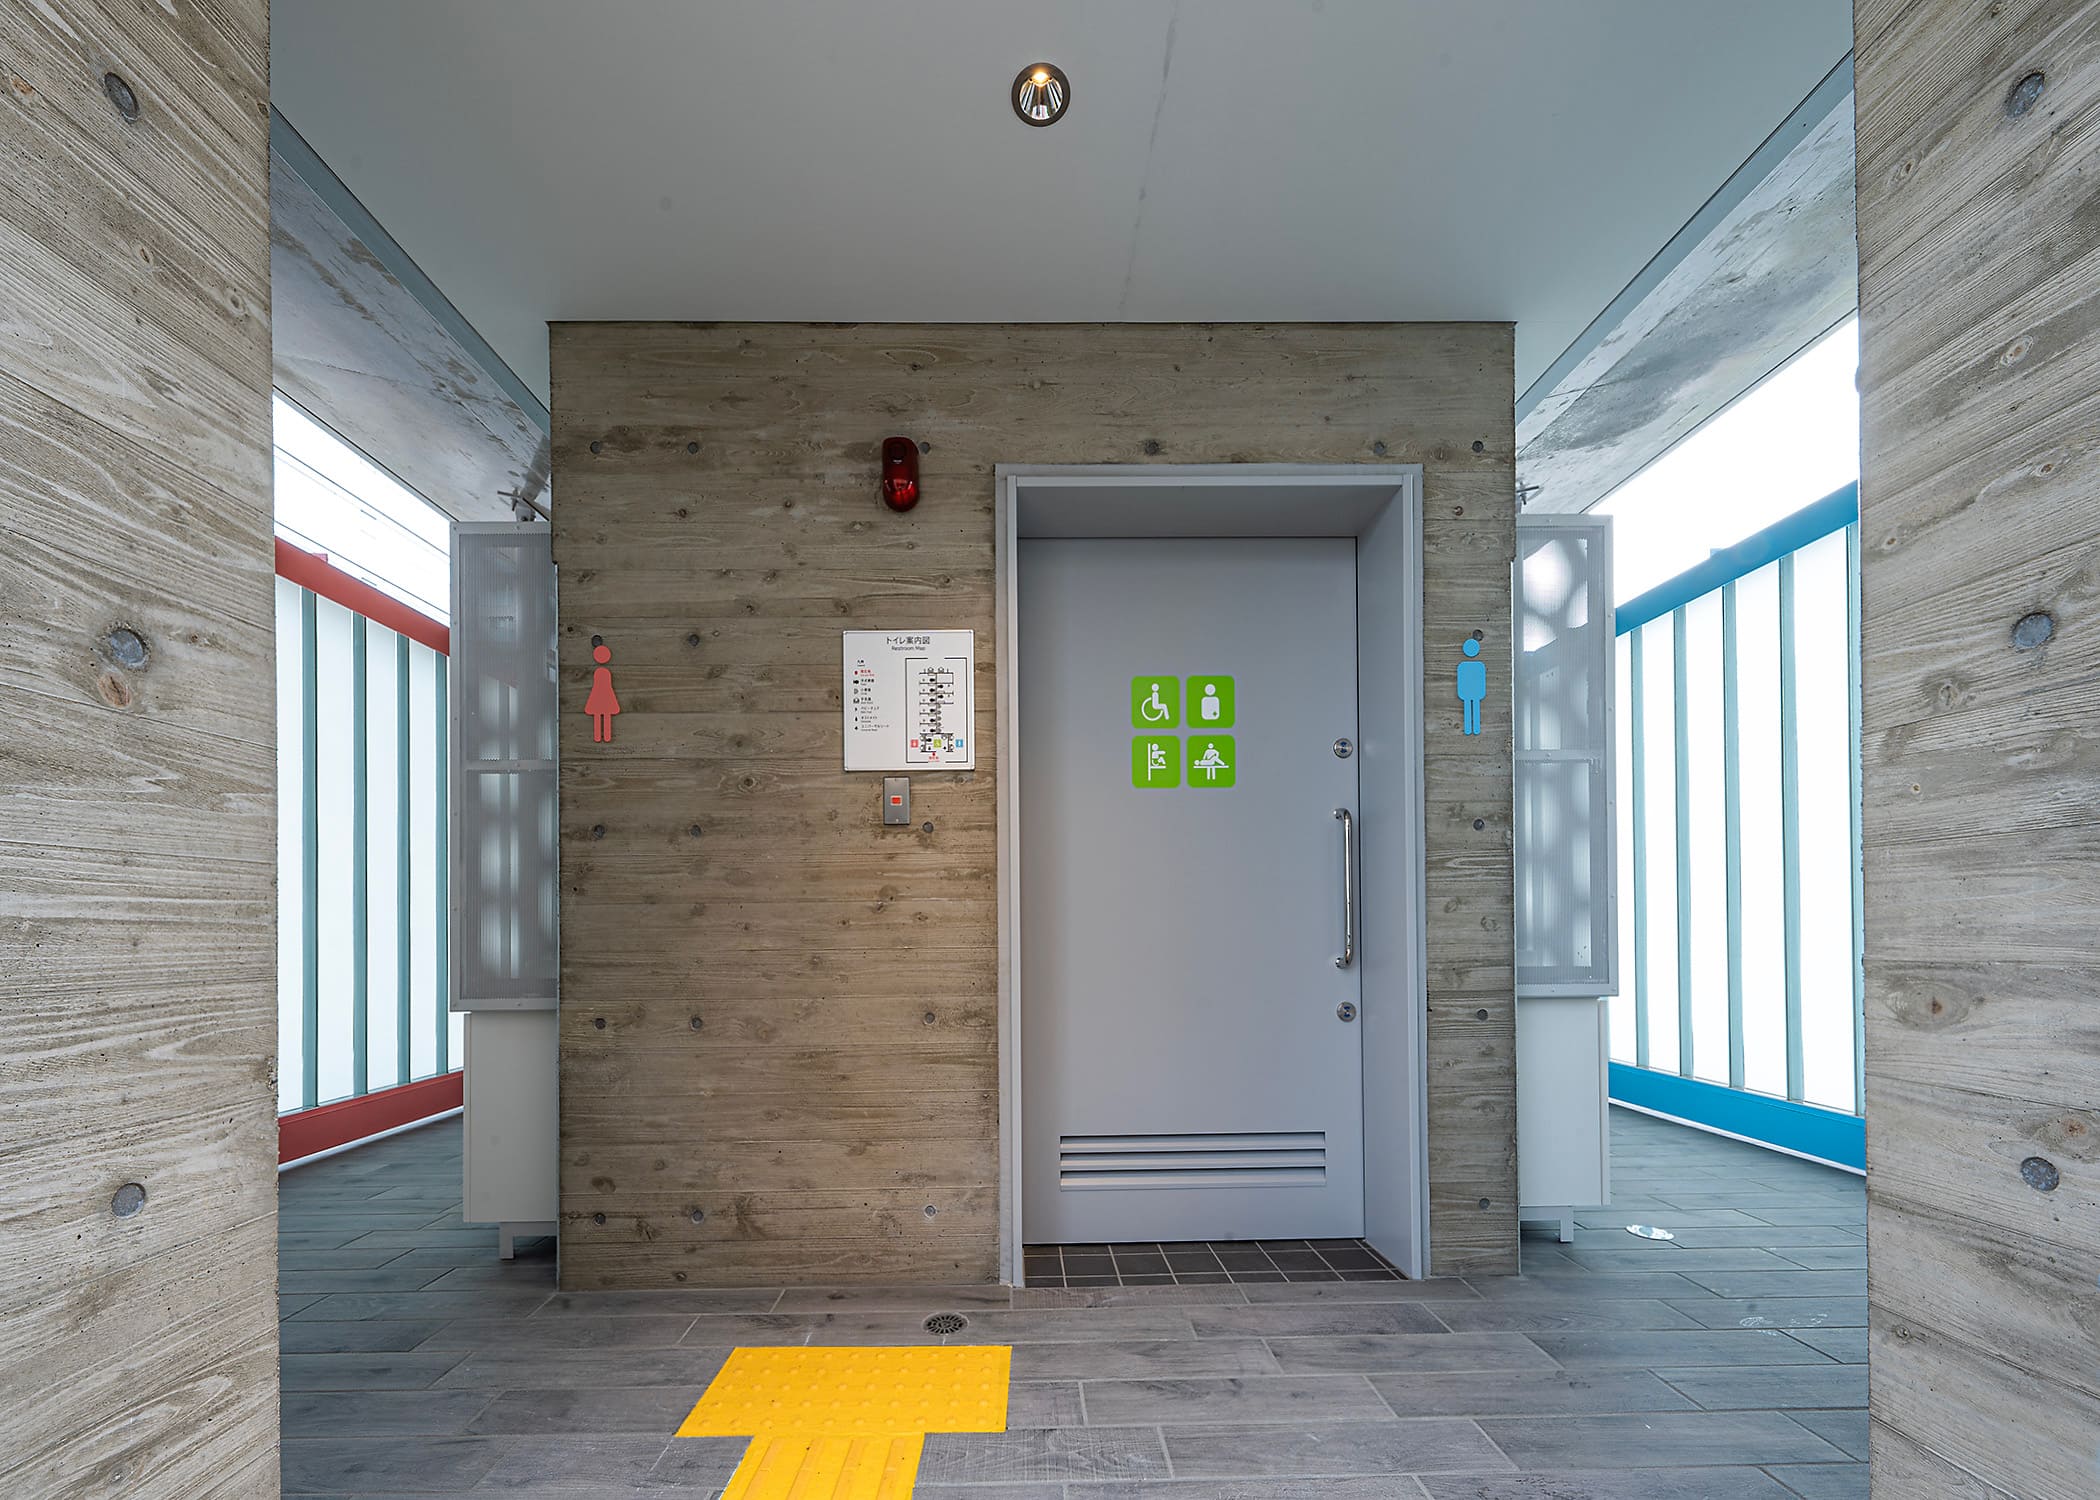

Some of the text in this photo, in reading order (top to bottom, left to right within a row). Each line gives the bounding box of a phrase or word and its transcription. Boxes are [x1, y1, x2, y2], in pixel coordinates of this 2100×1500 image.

[886, 636, 930, 645] トイレ案内図
